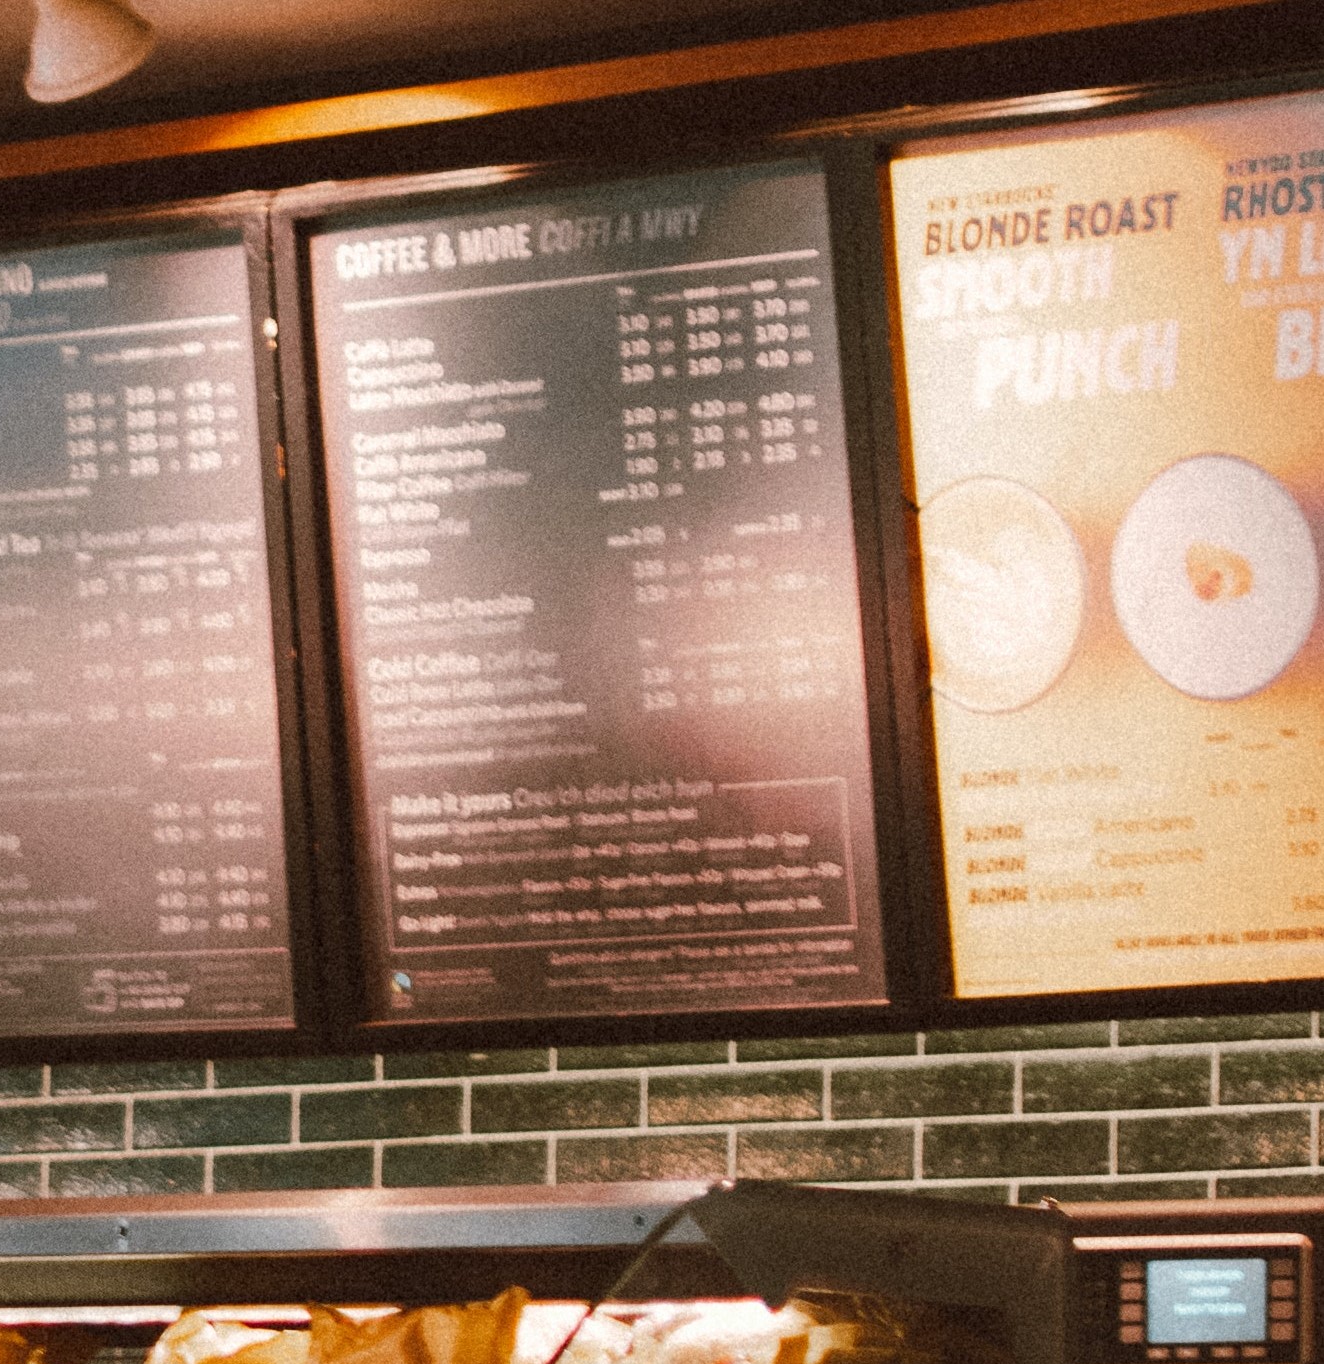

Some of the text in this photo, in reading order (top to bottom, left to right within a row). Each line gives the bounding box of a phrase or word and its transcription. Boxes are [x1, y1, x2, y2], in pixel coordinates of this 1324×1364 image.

[335, 232, 431, 281] COFFEE
[457, 223, 532, 263] MORE
[925, 192, 1179, 256] BLONDE ROAST
[1219, 224, 1286, 284] YN
[914, 244, 1114, 319] SMOOTH
[974, 318, 1181, 411] PUNCH
